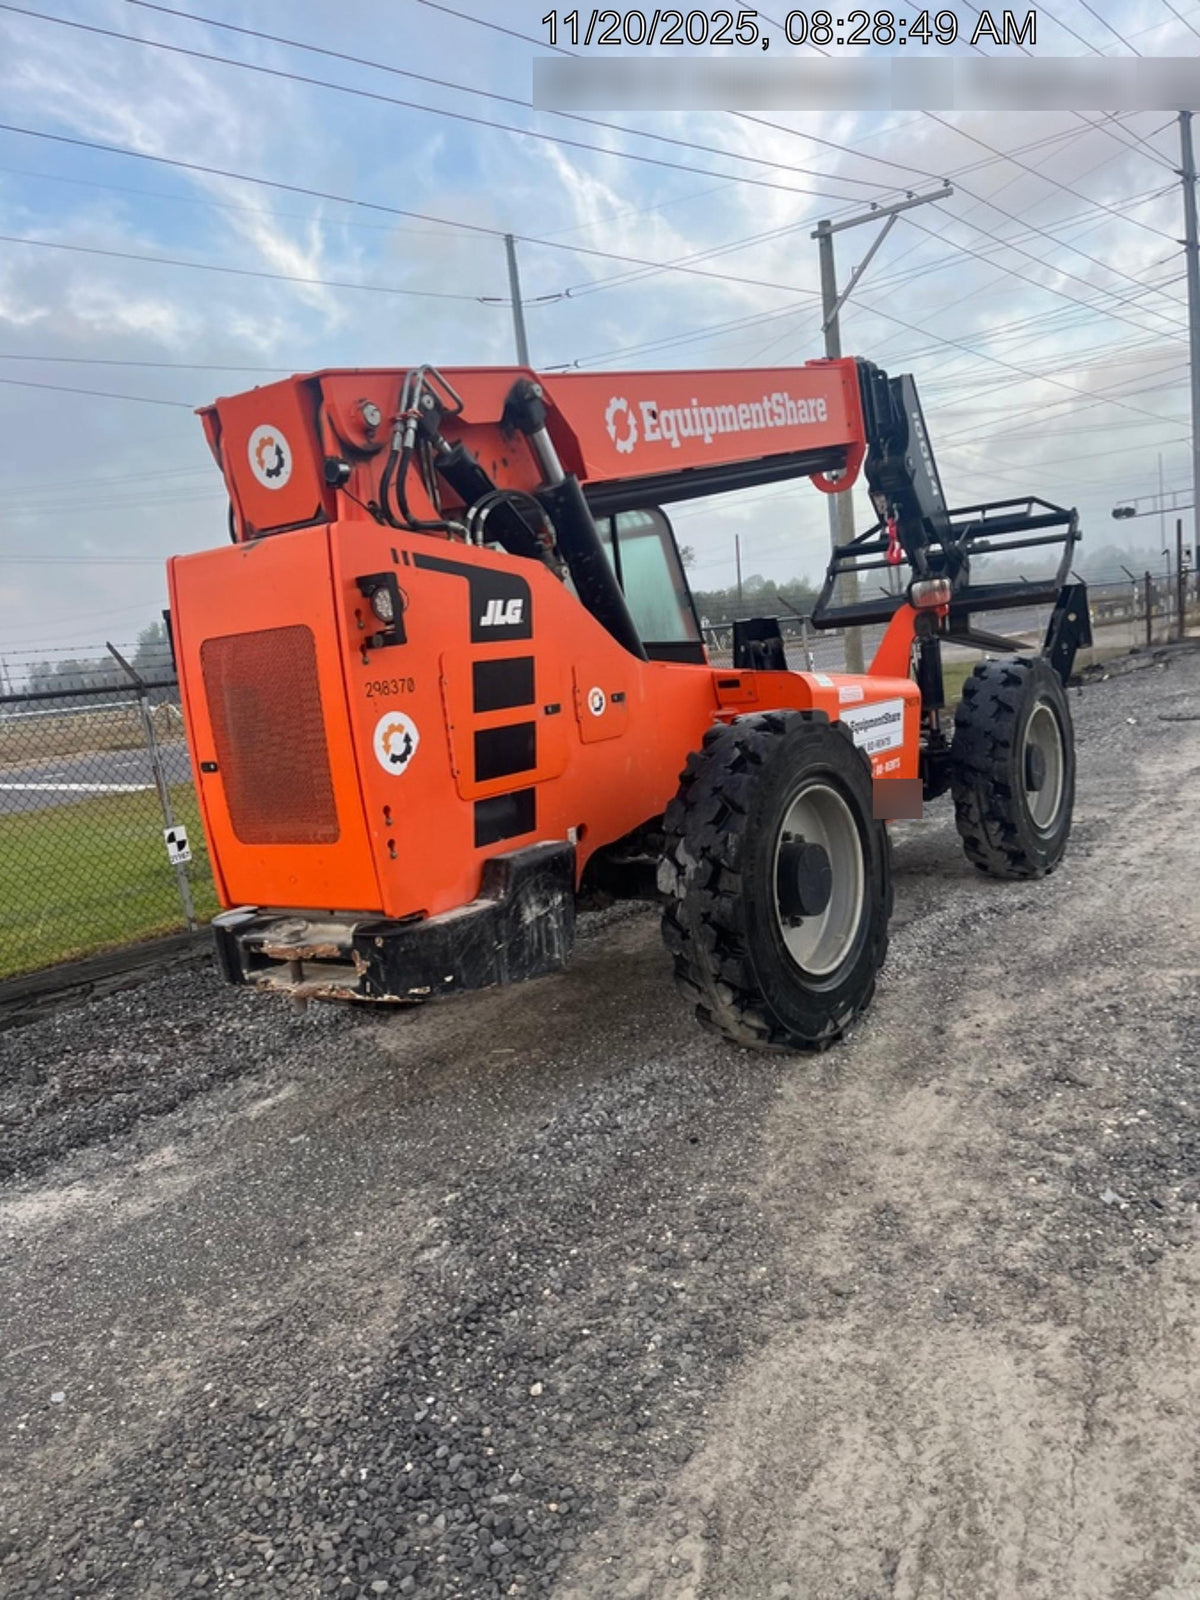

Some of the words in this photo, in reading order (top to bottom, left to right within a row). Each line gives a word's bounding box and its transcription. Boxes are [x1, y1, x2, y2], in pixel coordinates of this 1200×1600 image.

[638, 392, 828, 448] EquipmentShare
[479, 598, 524, 627] JLG
[365, 677, 415, 699] 298370
